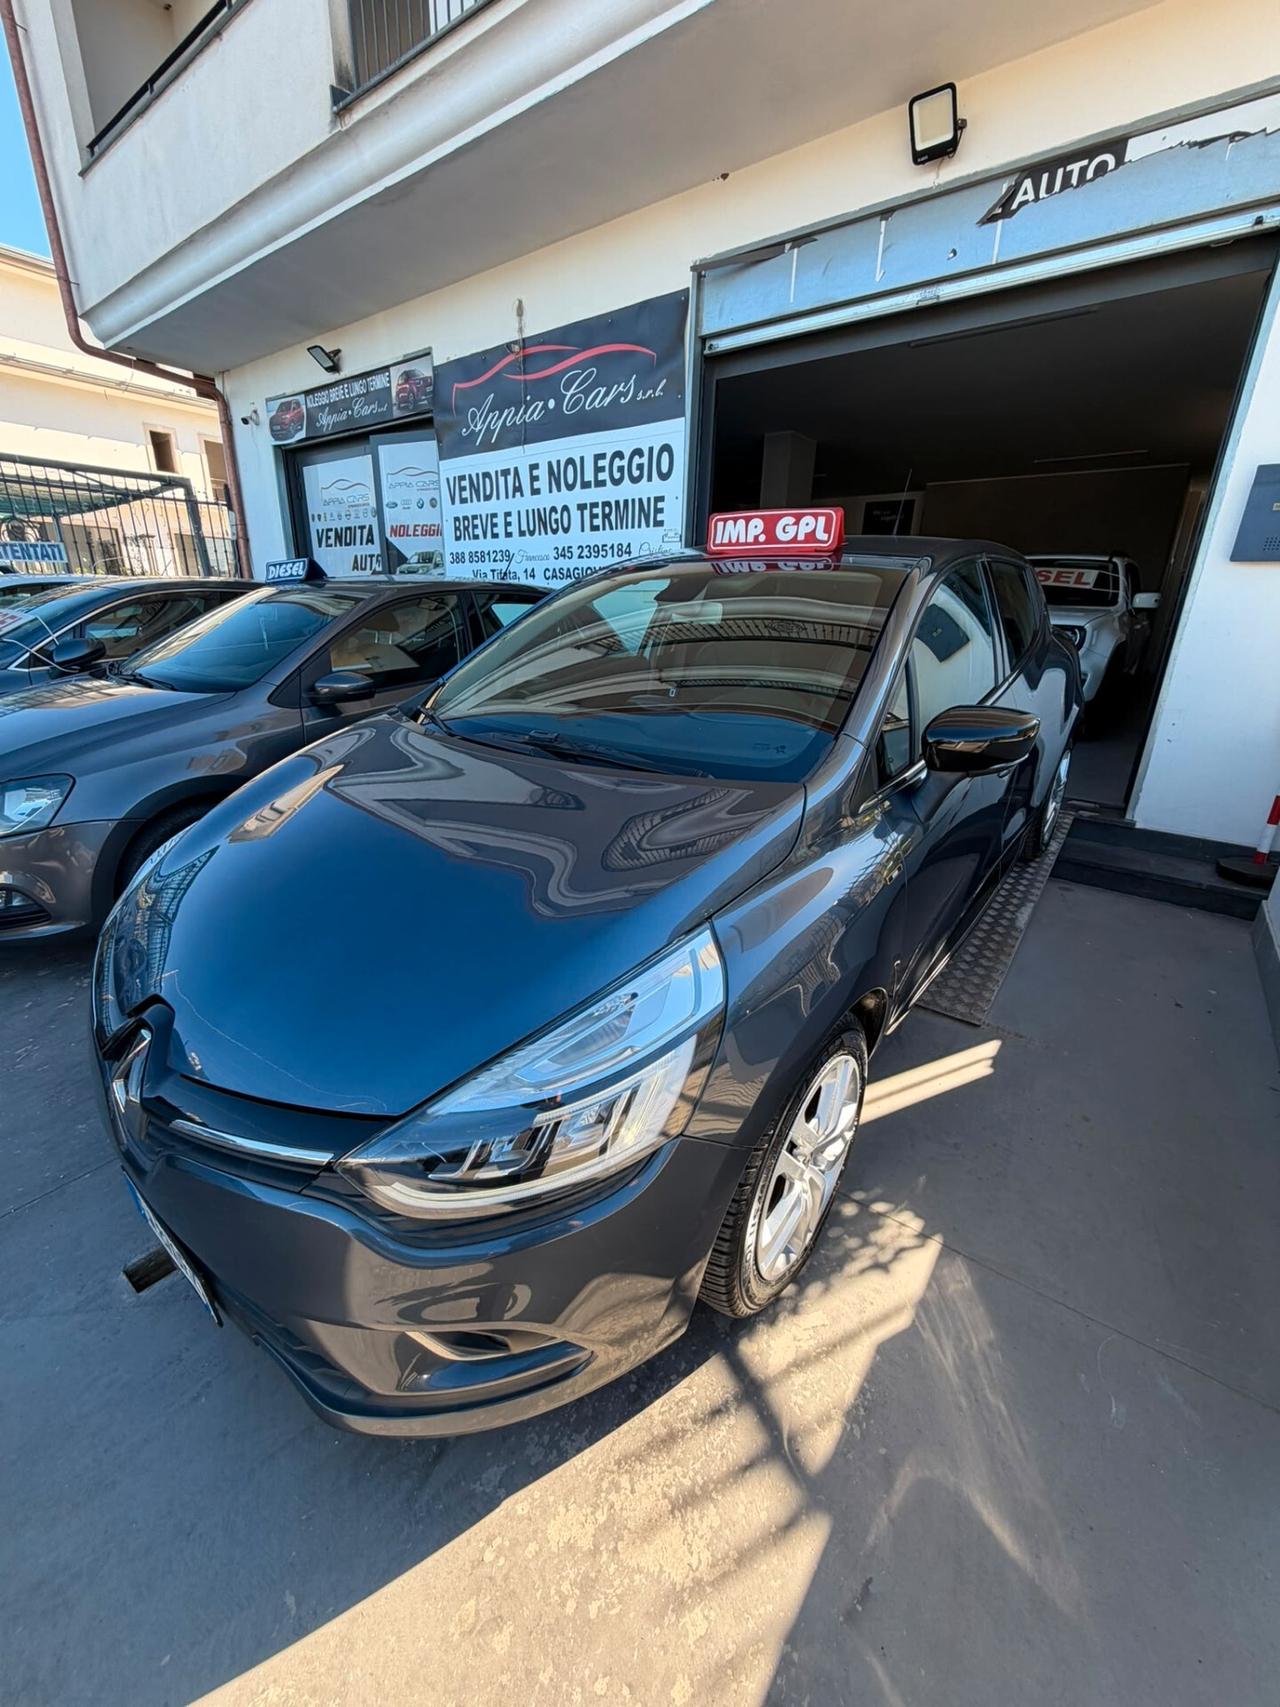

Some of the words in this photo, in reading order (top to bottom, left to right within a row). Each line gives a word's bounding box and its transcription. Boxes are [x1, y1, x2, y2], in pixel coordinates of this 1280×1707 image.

[1010, 153, 1116, 210] AUTO
[306, 390, 330, 409] NOLEGGIO
[329, 385, 345, 402] BREVE
[349, 379, 368, 397] LUNGO
[367, 372, 390, 392] TERMINE
[461, 393, 546, 446] Appia
[560, 367, 636, 415] Cars
[316, 407, 348, 431] Appia
[352, 397, 378, 418] Cars
[446, 466, 525, 505] VENDITA
[528, 463, 541, 496] E
[548, 443, 675, 494] NOLEGGIO
[453, 511, 499, 542] BREVE
[504, 511, 513, 539] E
[517, 504, 572, 538] LUNGO
[577, 495, 666, 533] TERMINE
[715, 518, 766, 544] IMP.
[775, 515, 829, 542] GPL
[316, 524, 375, 548] VENDITA
[267, 560, 305, 580] DIESEL
[449, 551, 466, 565] 388
[468, 549, 511, 564] 8581239
[553, 546, 574, 561] 345
[577, 543, 632, 560] 2395184
[472, 569, 488, 579] Via
[523, 567, 536, 580] 14
